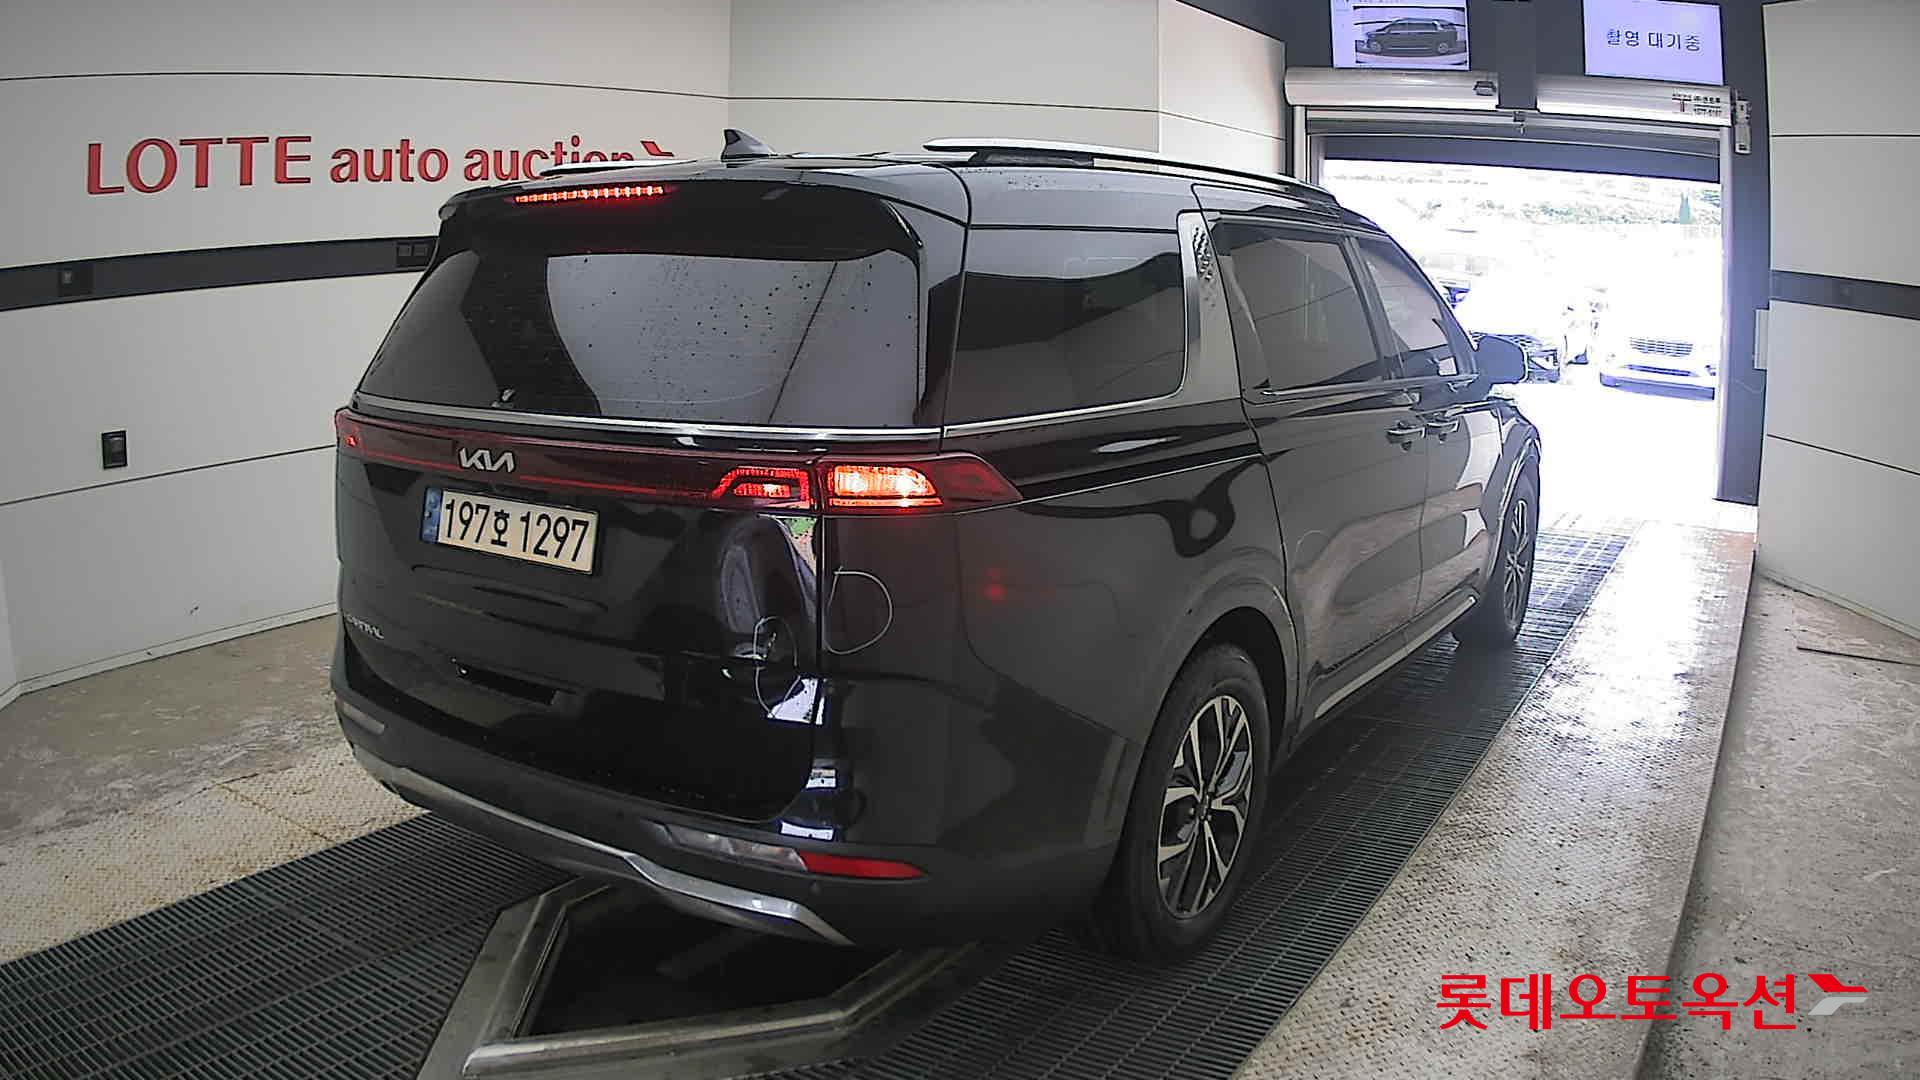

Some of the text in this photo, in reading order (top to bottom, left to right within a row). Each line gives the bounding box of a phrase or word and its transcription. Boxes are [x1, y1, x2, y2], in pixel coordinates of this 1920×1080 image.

[1607, 28, 1640, 47] 촬영
[87, 136, 312, 195] LOTTE
[330, 138, 449, 182] auto
[458, 447, 515, 473] KIA
[445, 499, 510, 547] 197호
[520, 511, 589, 562] 1297
